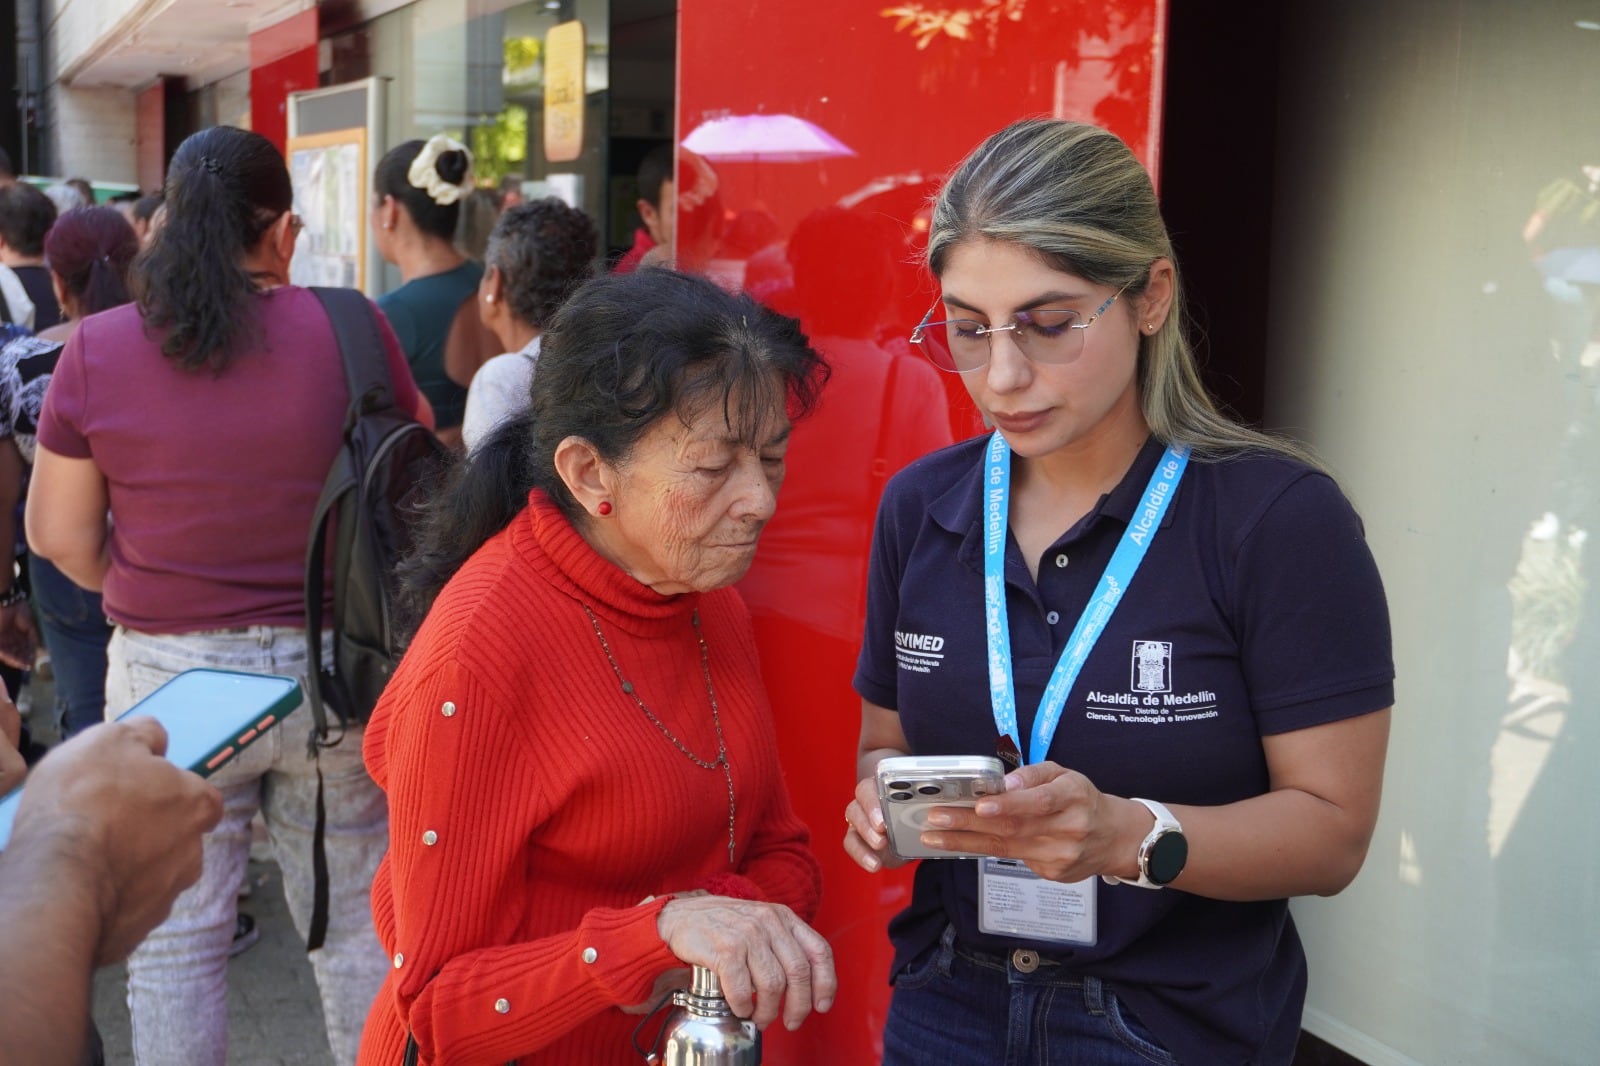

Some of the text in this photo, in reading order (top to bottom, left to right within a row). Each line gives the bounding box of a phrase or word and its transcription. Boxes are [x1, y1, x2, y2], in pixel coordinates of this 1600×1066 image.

[990, 466, 1005, 485] de
[1129, 481, 1170, 547] Alcaldía
[1163, 460, 1179, 480] de
[988, 488, 1004, 556] Medellín
[1086, 690, 1216, 706] Alcaldía de Medellín
[1086, 711, 1118, 722] Ciencia,
[1175, 711, 1218, 721] Innovación
[1135, 707, 1169, 715] Distrito de
